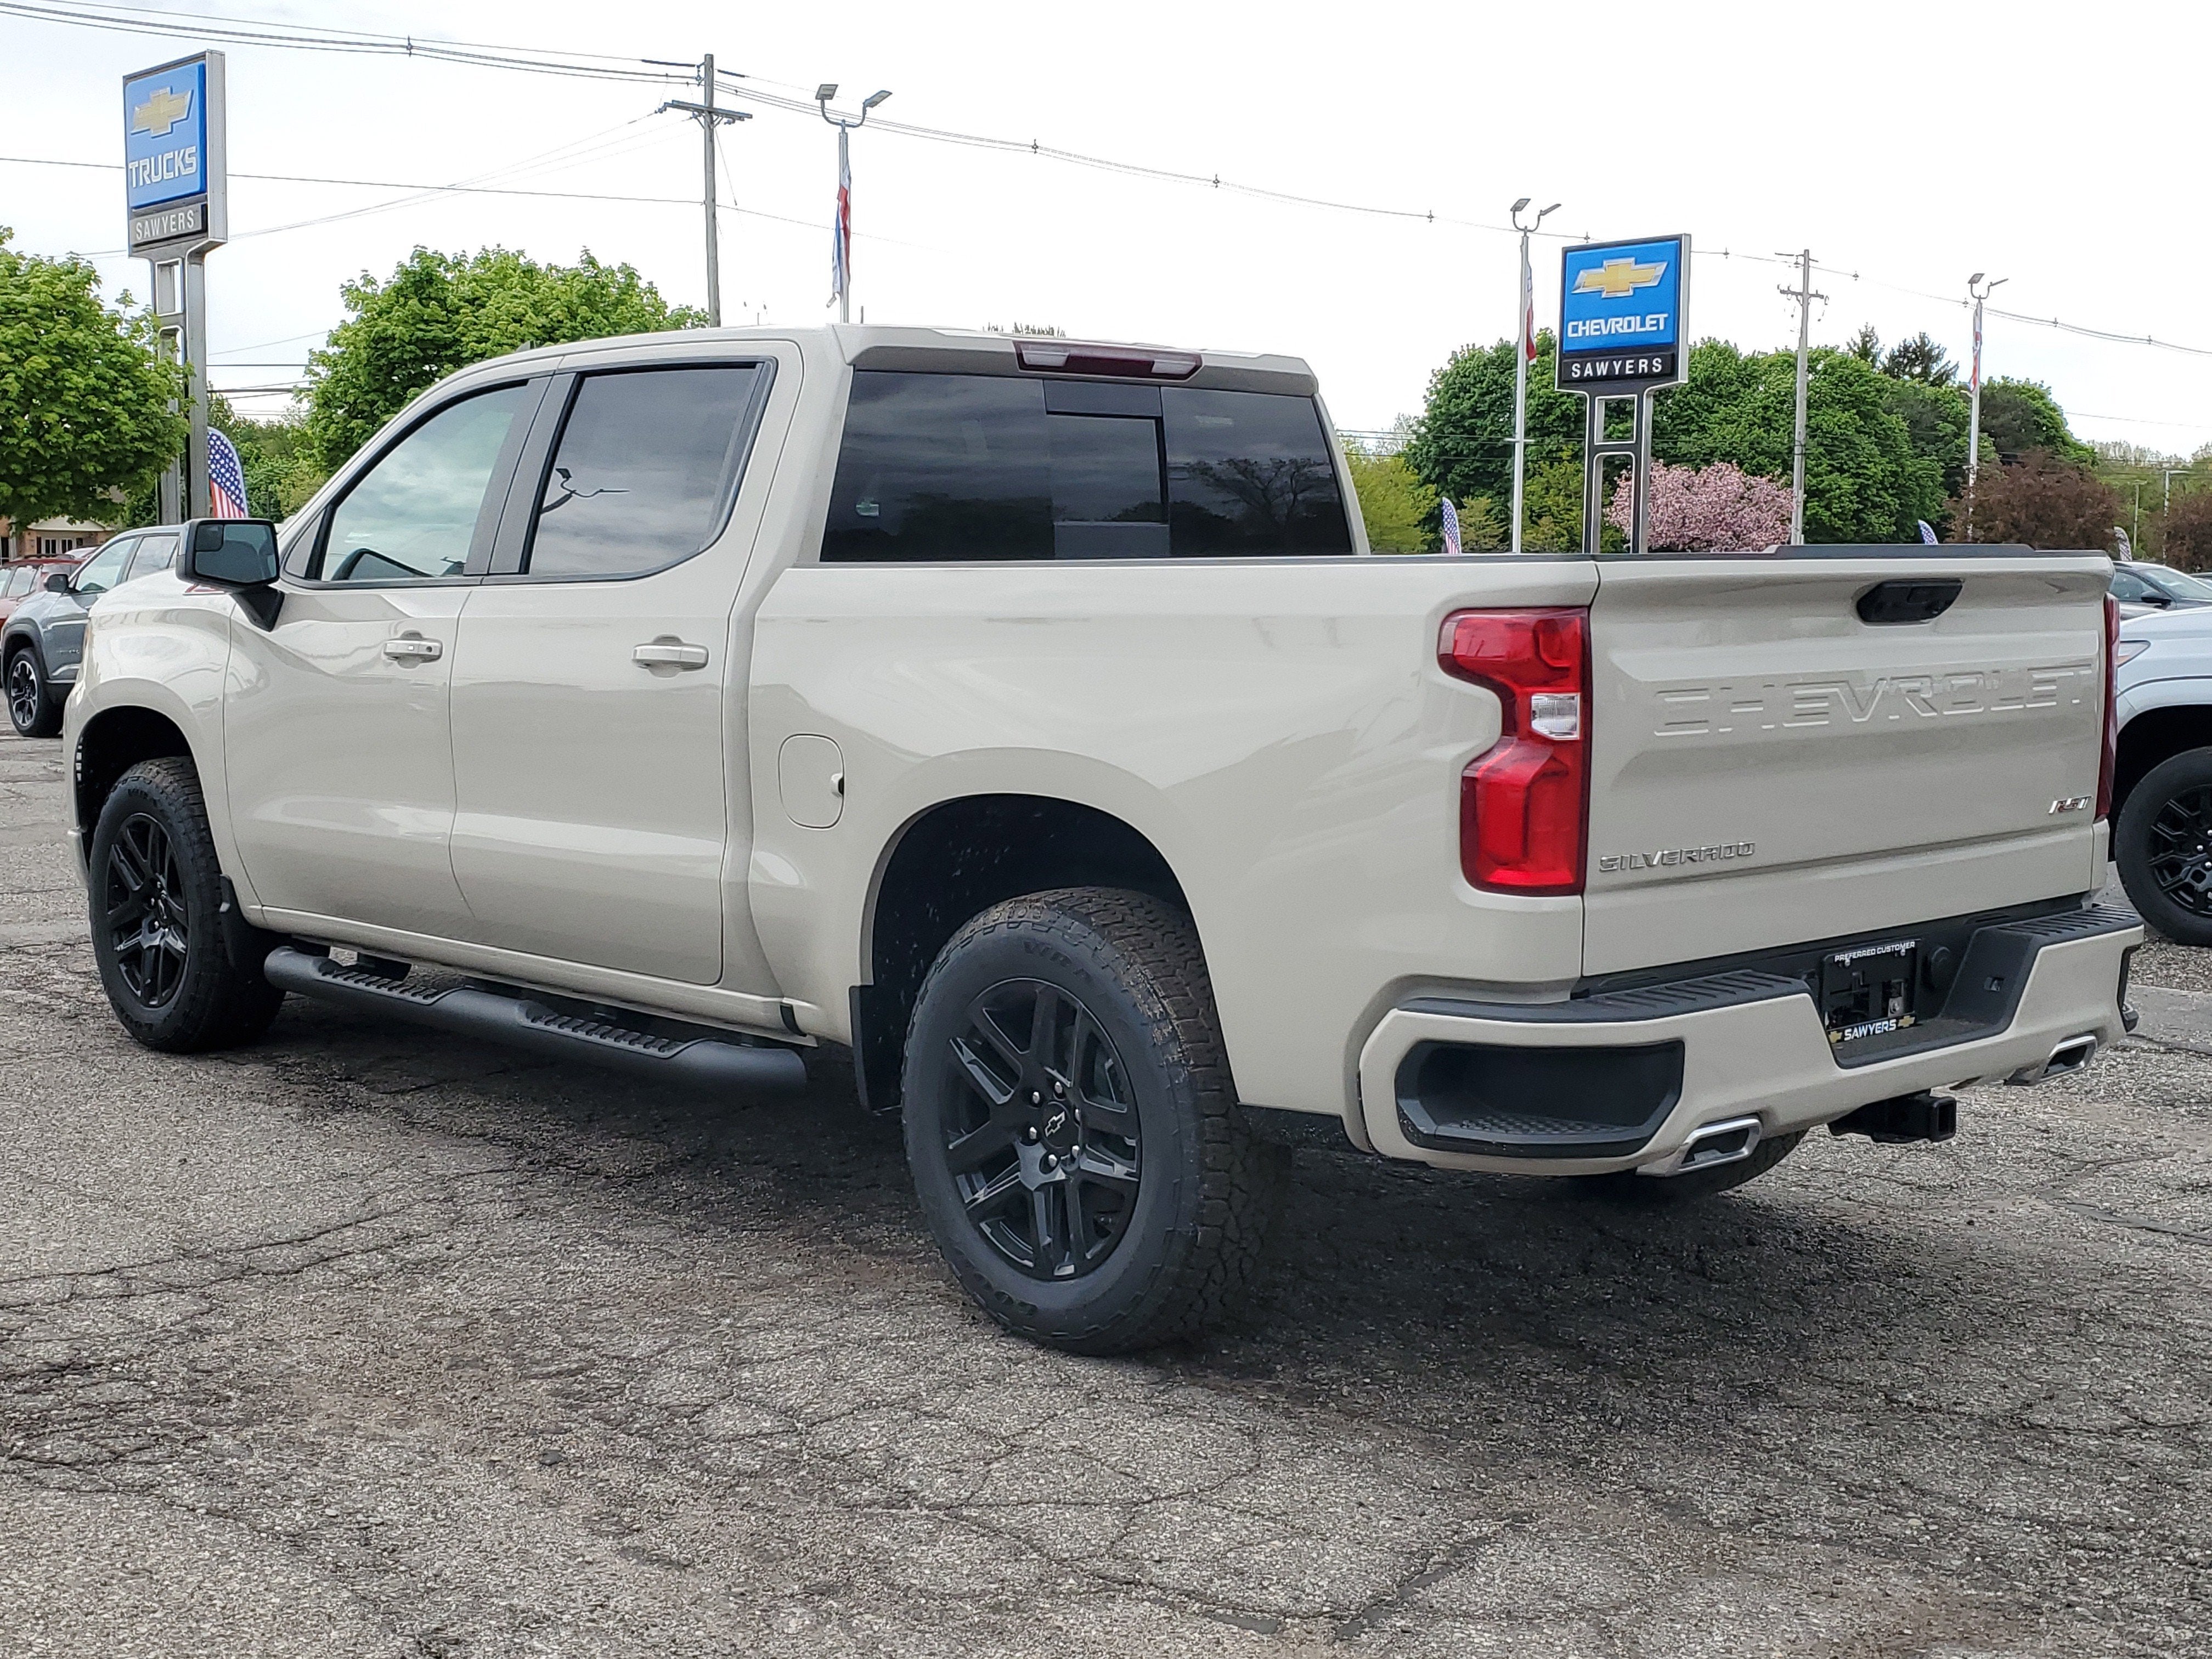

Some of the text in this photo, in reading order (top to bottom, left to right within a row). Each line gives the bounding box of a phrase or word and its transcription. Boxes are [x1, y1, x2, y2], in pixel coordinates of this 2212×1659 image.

[128, 145, 197, 188] TRUCKS
[136, 209, 194, 241] SAWYERS
[1567, 313, 1669, 337] CHEVROLET
[1571, 357, 1662, 378] SAWYERS
[1654, 663, 2092, 737] CHEVROLET
[1599, 841, 1755, 871] SILVERADO
[1834, 941, 1916, 963] PREFERRED CUSTOMER
[1844, 1019, 1897, 1041] SAWYERS
